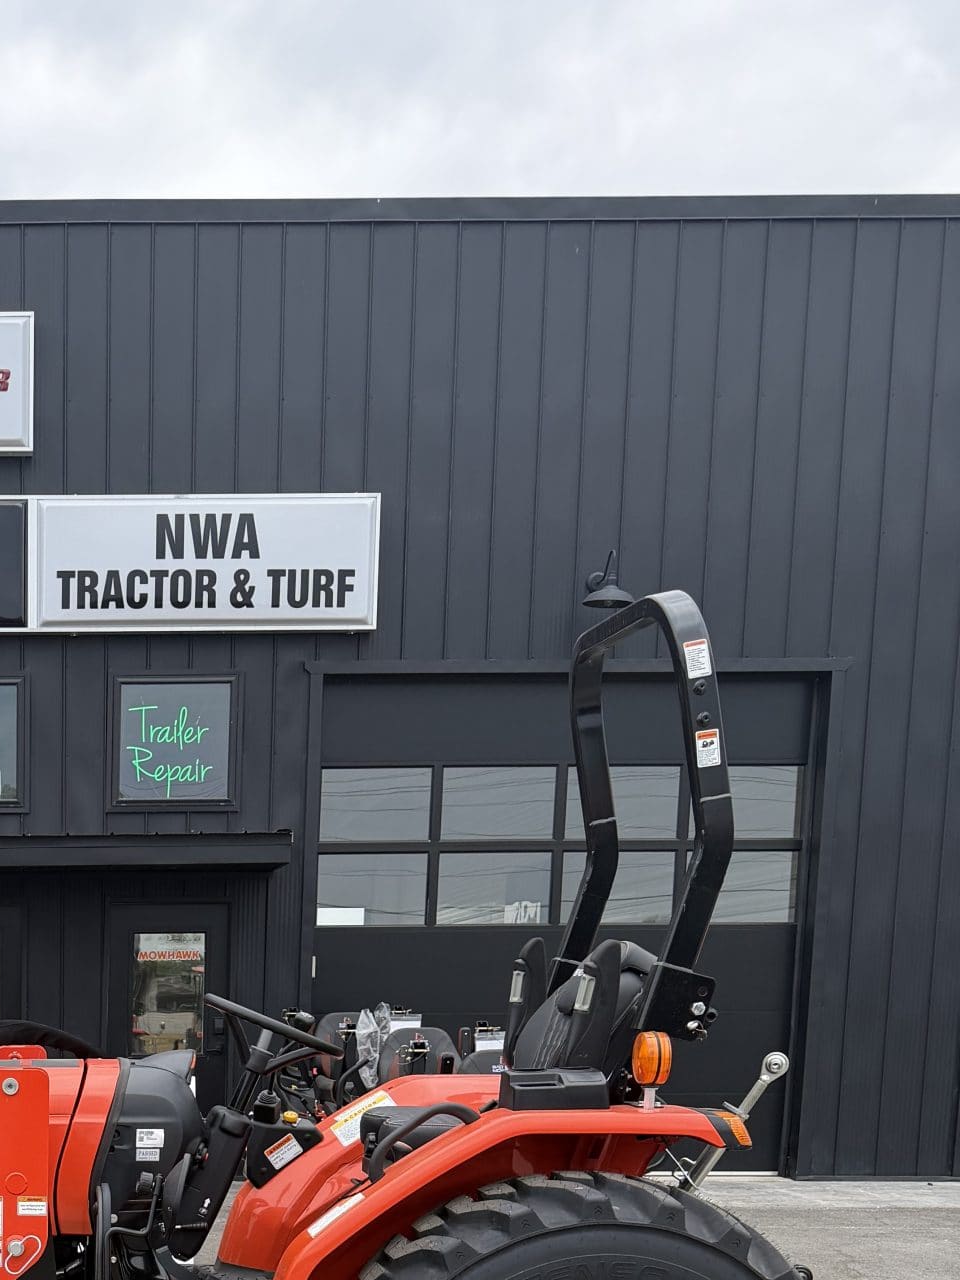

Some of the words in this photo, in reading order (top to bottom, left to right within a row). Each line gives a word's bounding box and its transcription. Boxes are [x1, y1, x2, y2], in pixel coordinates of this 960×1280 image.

[155, 513, 261, 560] NWA
[56, 569, 217, 609] TRACTOR
[229, 568, 256, 609] &
[266, 568, 356, 608] TURF
[127, 705, 210, 751] Trailer
[126, 746, 214, 799] Repair
[138, 950, 201, 960] MOWHAWK
